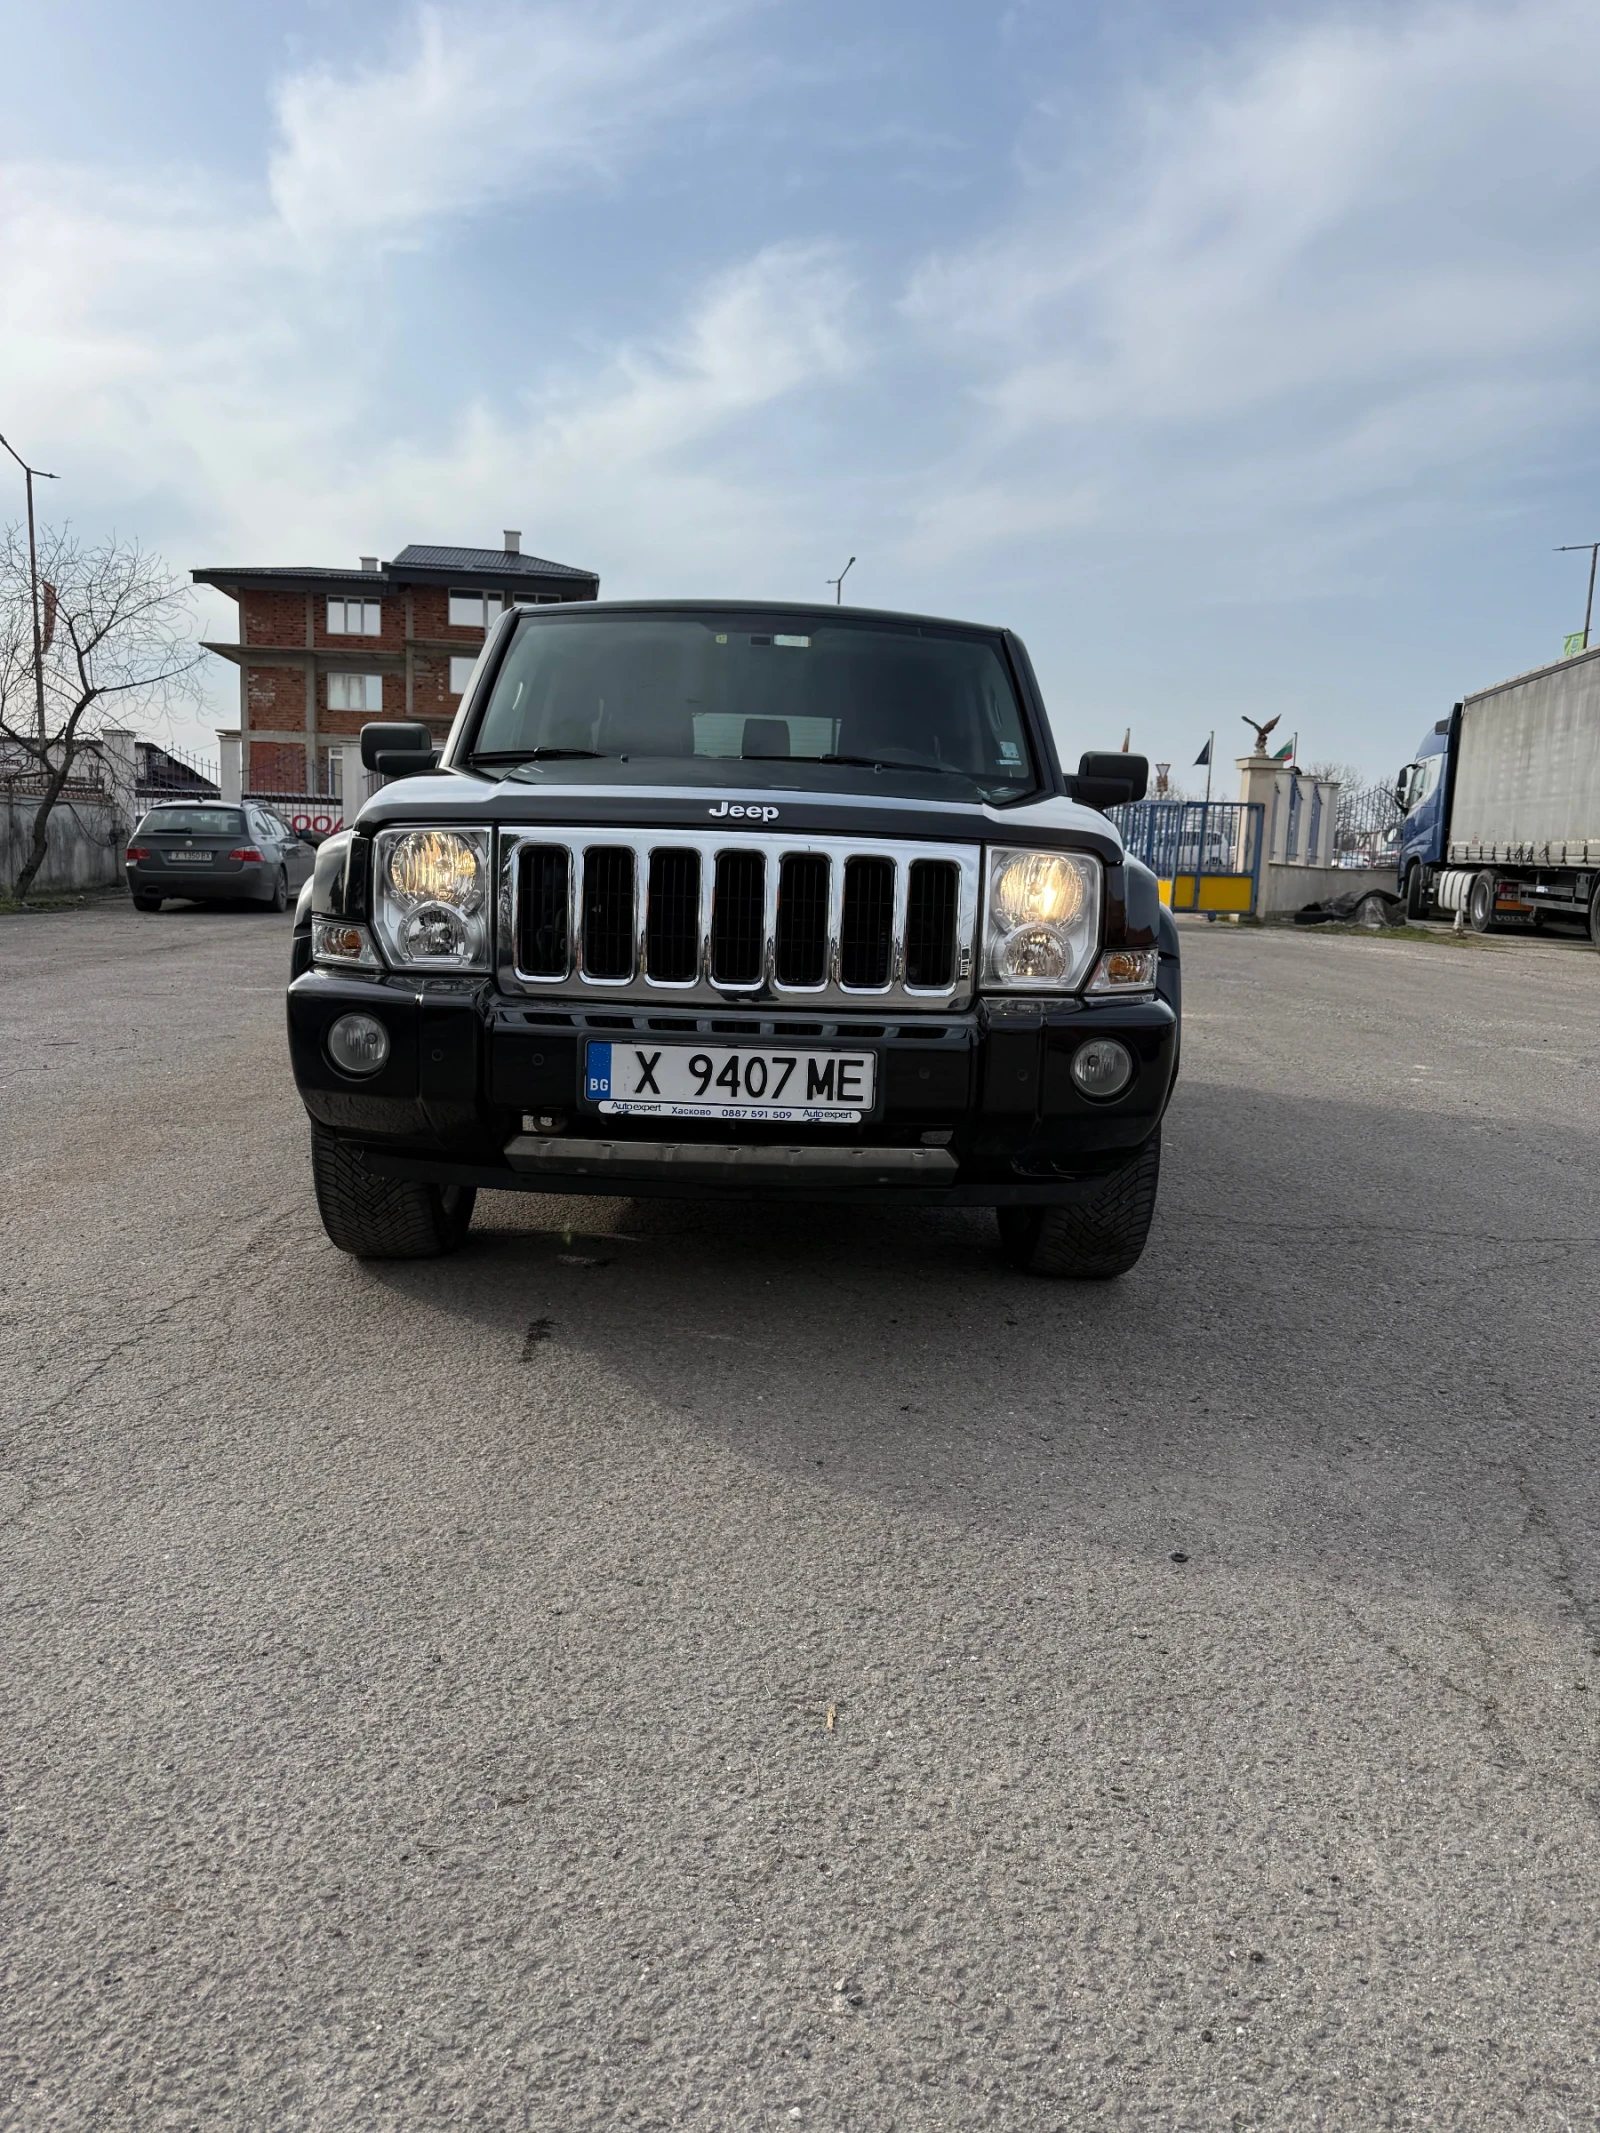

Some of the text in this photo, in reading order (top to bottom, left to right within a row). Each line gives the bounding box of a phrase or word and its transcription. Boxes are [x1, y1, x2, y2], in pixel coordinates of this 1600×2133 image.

[708, 801, 780, 823] Jeep
[1495, 914, 1531, 922] VOLV
[634, 1051, 864, 1102] X 9407 ME
[589, 1077, 609, 1092] BG
[671, 1106, 712, 1116] Хасково
[721, 1108, 747, 1118] 0887
[750, 1110, 768, 1119] 591
[772, 1111, 792, 1119] 509
